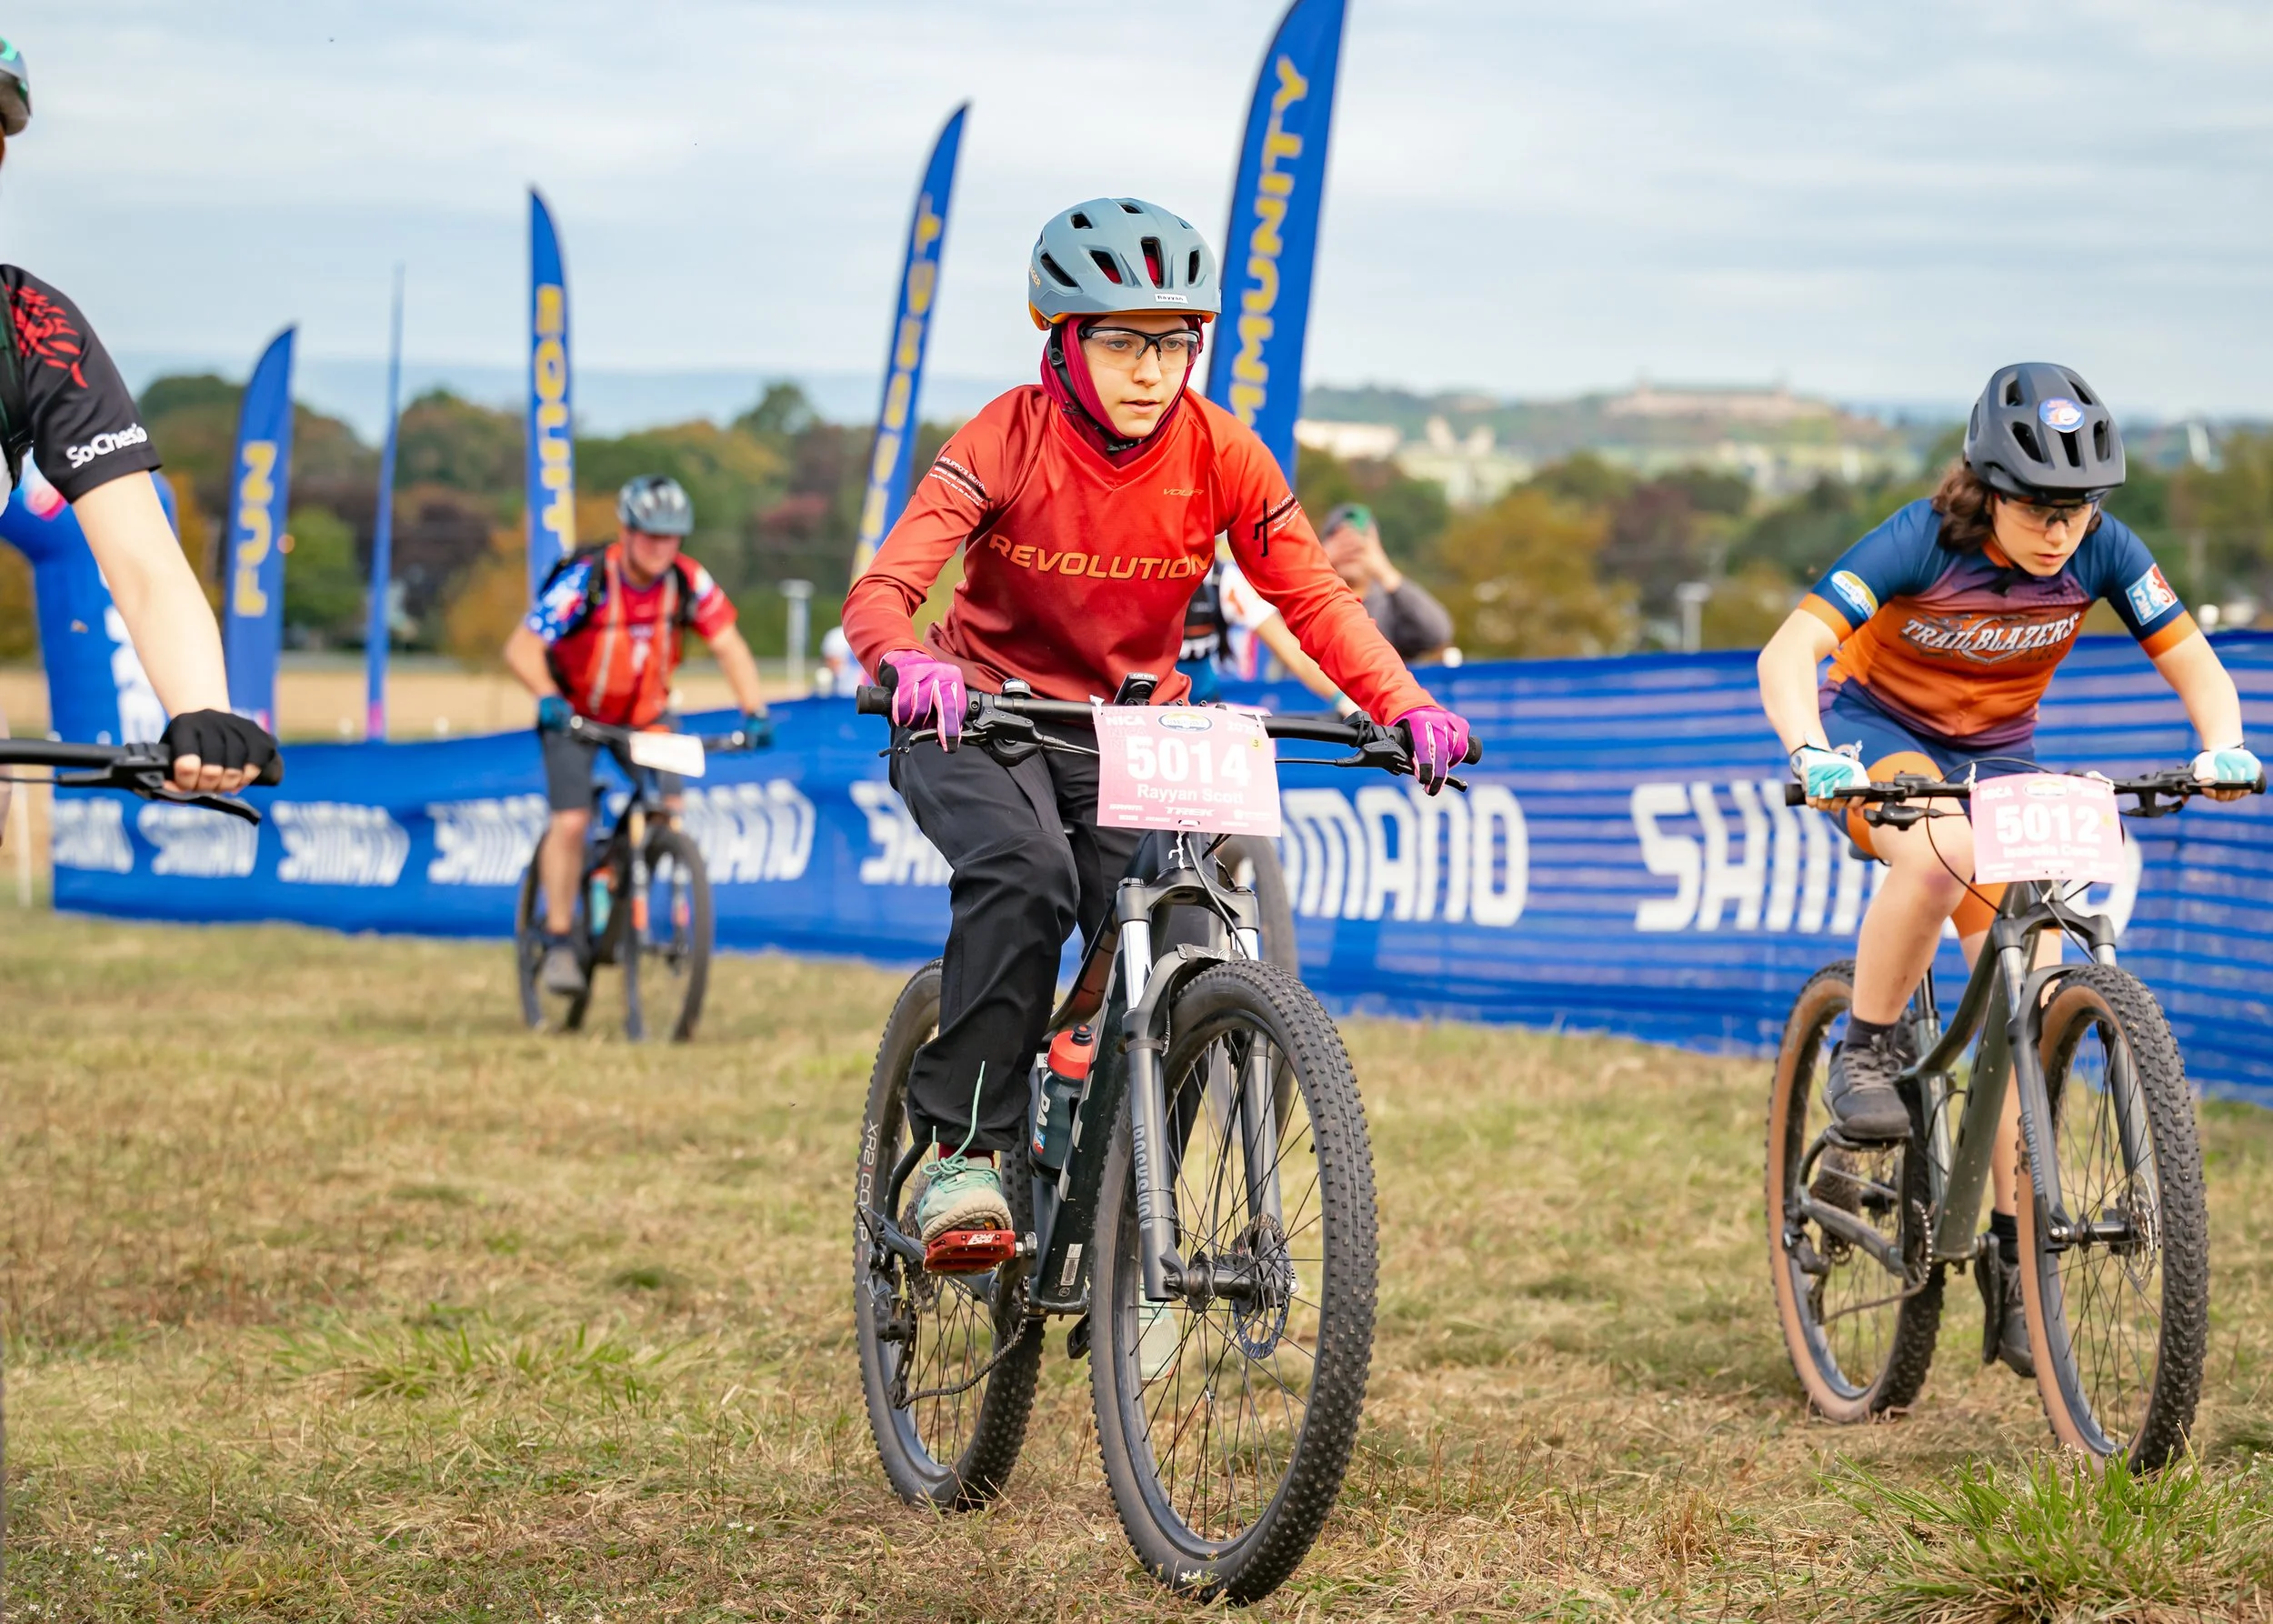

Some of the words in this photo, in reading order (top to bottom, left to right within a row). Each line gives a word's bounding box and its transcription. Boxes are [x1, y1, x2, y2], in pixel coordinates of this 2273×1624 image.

[234, 440, 279, 617] FUN
[989, 534, 1213, 580] REVOLUTION
[1106, 714, 1147, 727] NICA
[1126, 735, 1252, 787] 5014
[1136, 784, 1198, 804] Rayyan
[1201, 787, 1245, 805] Scott
[1164, 806, 1217, 817] TREK
[1995, 802, 2103, 845] 5012
[864, 1119, 879, 1166] XR2
